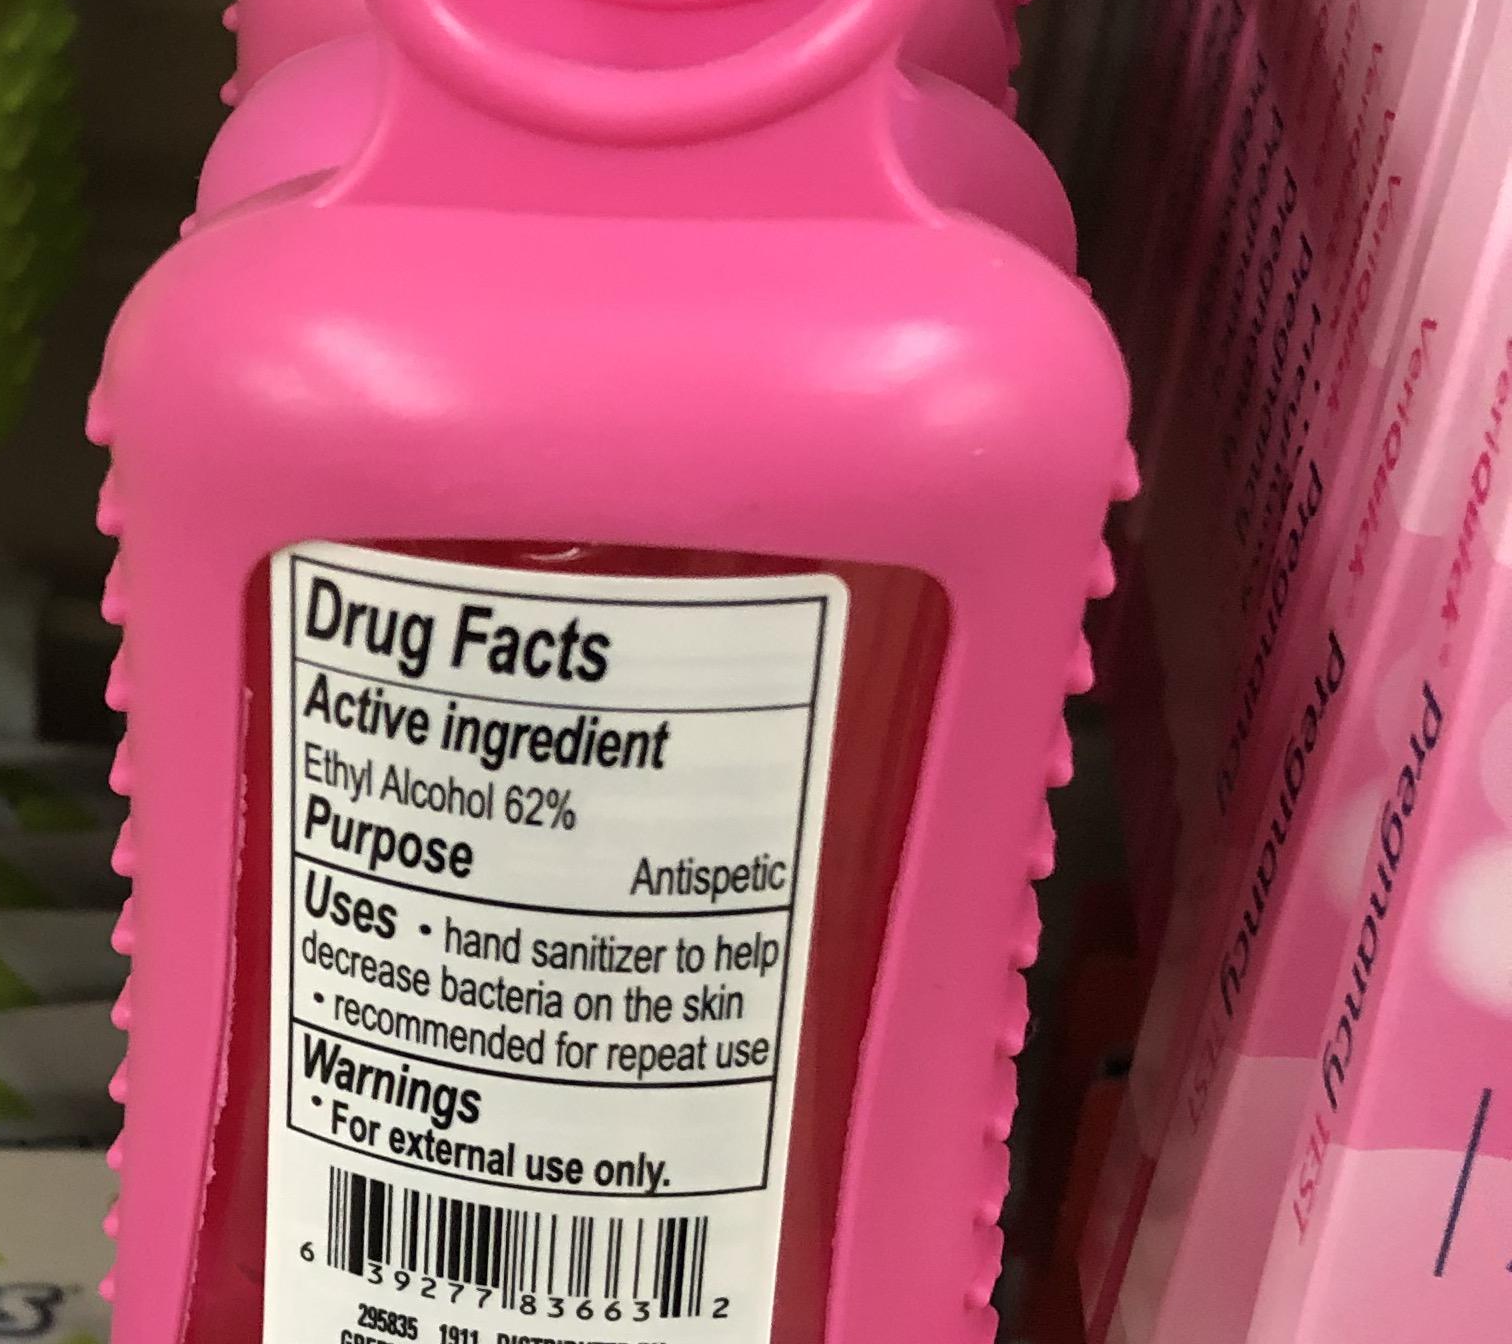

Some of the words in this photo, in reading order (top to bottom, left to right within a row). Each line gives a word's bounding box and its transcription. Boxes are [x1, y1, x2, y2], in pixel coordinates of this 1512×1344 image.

[305, 576, 435, 679] Drug
[451, 604, 613, 682] Facts
[304, 673, 430, 746] Active
[441, 701, 671, 771] ingredient
[304, 742, 374, 803] Ethyl
[380, 763, 494, 822] Alcohol
[504, 785, 577, 831] 62%
[1219, 629, 1348, 1021] pregnancy
[304, 793, 475, 878] Purpose
[630, 852, 788, 904] Antispetic
[303, 870, 398, 940] Uses
[445, 916, 522, 965] hand
[531, 934, 668, 975] sanitizer
[676, 938, 705, 974] to
[714, 932, 780, 978] help
[1322, 680, 1444, 1112] pregnancy
[301, 929, 431, 997] decrease
[440, 965, 563, 1021] bacteria
[574, 993, 613, 1023] on
[623, 988, 673, 1024] the
[682, 983, 744, 1022] skin
[303, 1032, 484, 1131] Warnings
[333, 992, 546, 1066] recommended
[556, 1029, 596, 1069] for
[605, 1041, 706, 1081] repeat
[716, 1036, 771, 1069] use
[330, 1101, 378, 1148] For
[388, 1130, 516, 1179] external
[525, 1154, 582, 1186] use
[593, 1152, 672, 1195] only.
[299, 1241, 316, 1263] 6
[712, 1296, 731, 1320] 2
[357, 1302, 419, 1341] 295835
